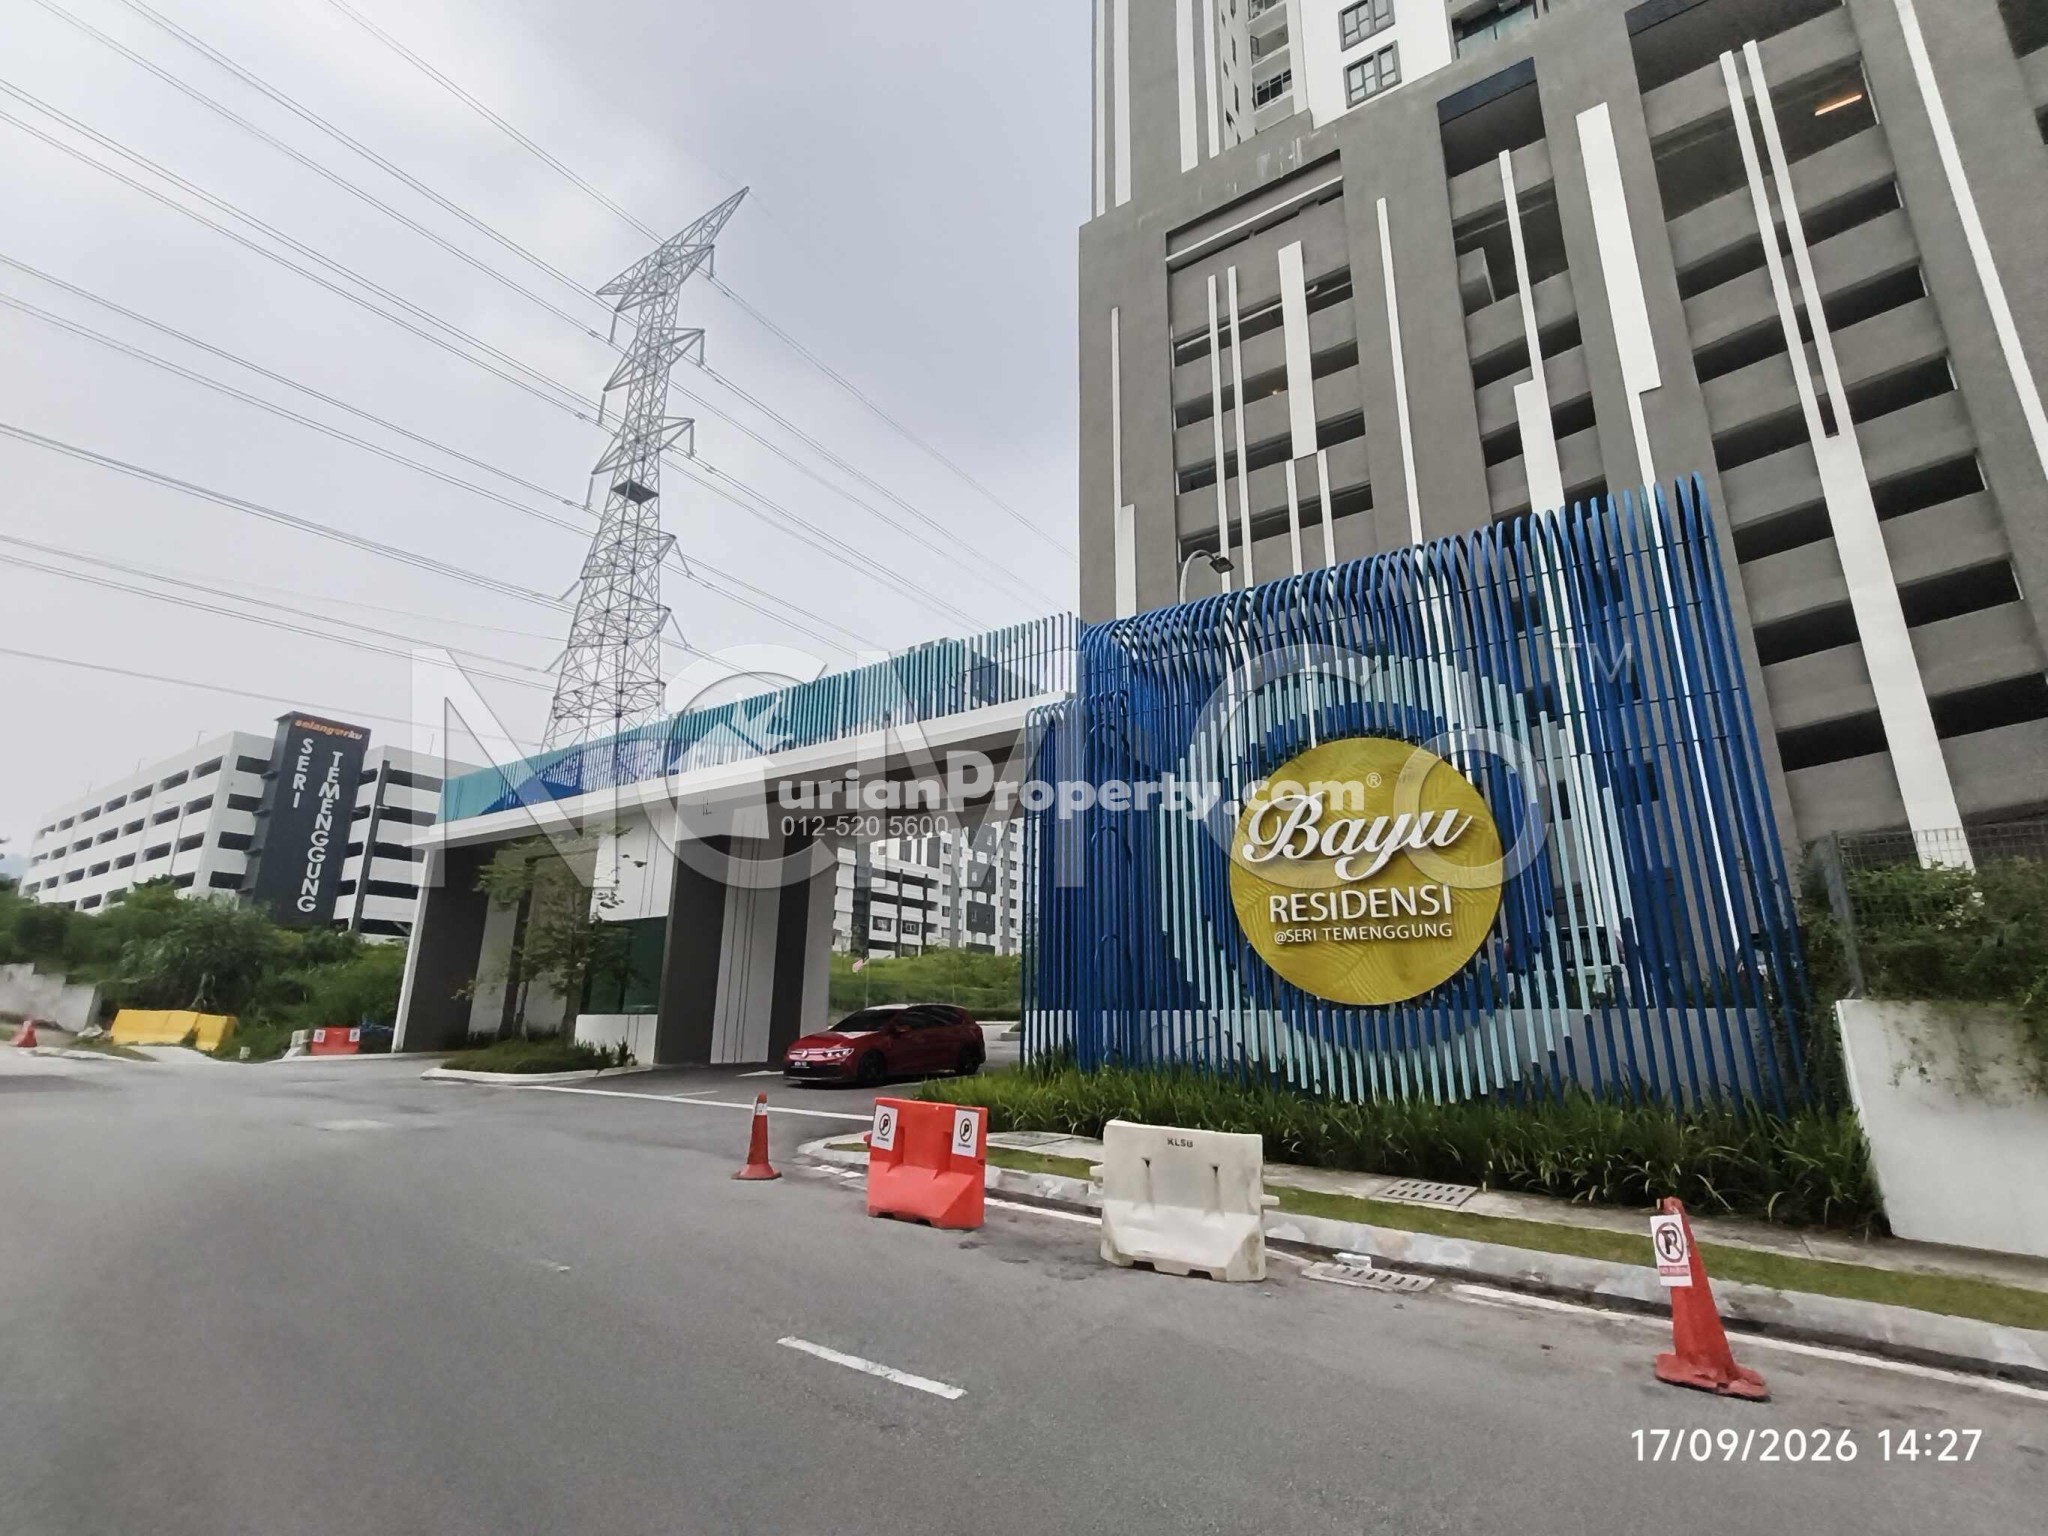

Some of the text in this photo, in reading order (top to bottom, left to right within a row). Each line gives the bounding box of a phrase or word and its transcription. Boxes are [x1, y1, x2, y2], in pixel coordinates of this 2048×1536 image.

[292, 738, 314, 808] SERI
[297, 751, 343, 912] TEMENGGUNG
[1242, 791, 1473, 882] Bayu
[1269, 883, 1452, 923] RESIDENSI
[1274, 922, 1453, 945] @SERI TEMENGGUNG
